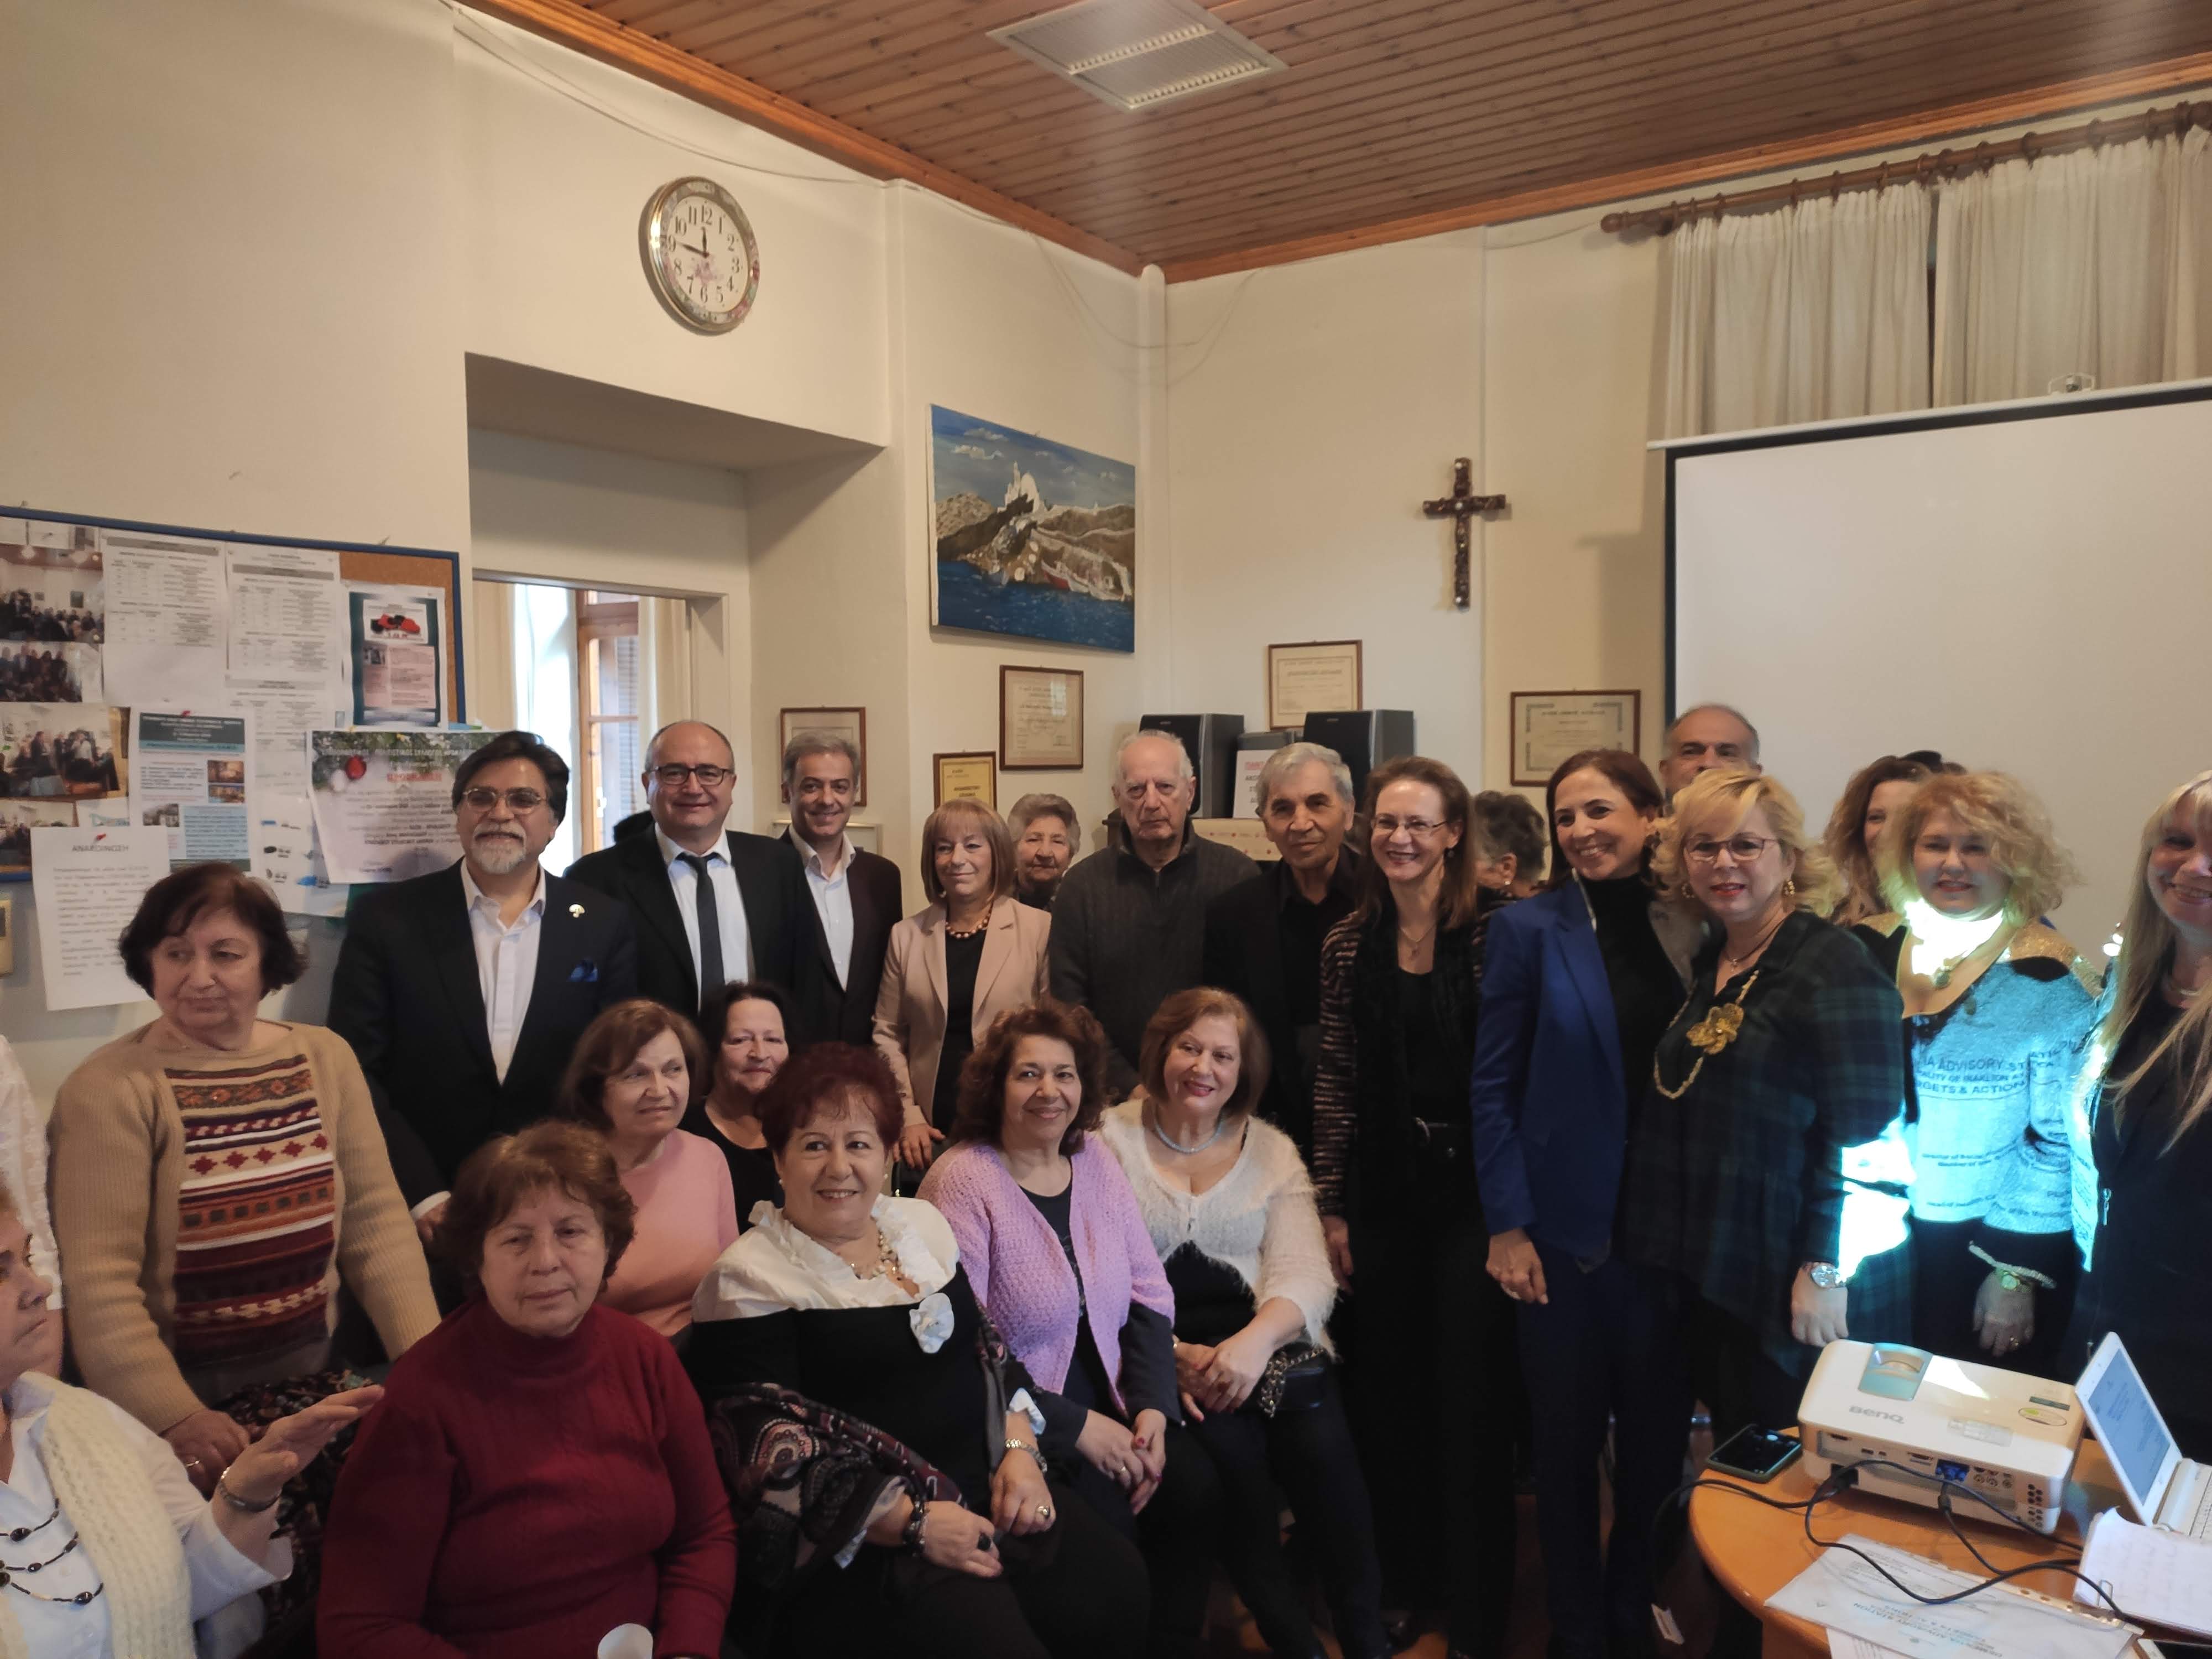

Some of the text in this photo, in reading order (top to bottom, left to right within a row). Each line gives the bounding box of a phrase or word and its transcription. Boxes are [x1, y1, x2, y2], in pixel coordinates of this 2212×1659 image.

[688, 205, 697, 226] 11
[701, 205, 712, 225] 12
[675, 216, 687, 236] 10
[719, 216, 722, 234] 1
[668, 234, 676, 252] 9
[727, 234, 735, 252] 2
[674, 258, 682, 275] 8
[732, 257, 740, 273] 3
[687, 275, 693, 294] 7
[727, 275, 734, 291] 4
[700, 286, 708, 304] 6
[717, 285, 723, 303] 5
[1937, 1055, 2004, 1072] ADVISORY
[1849, 1405, 1905, 1424] BenQ
